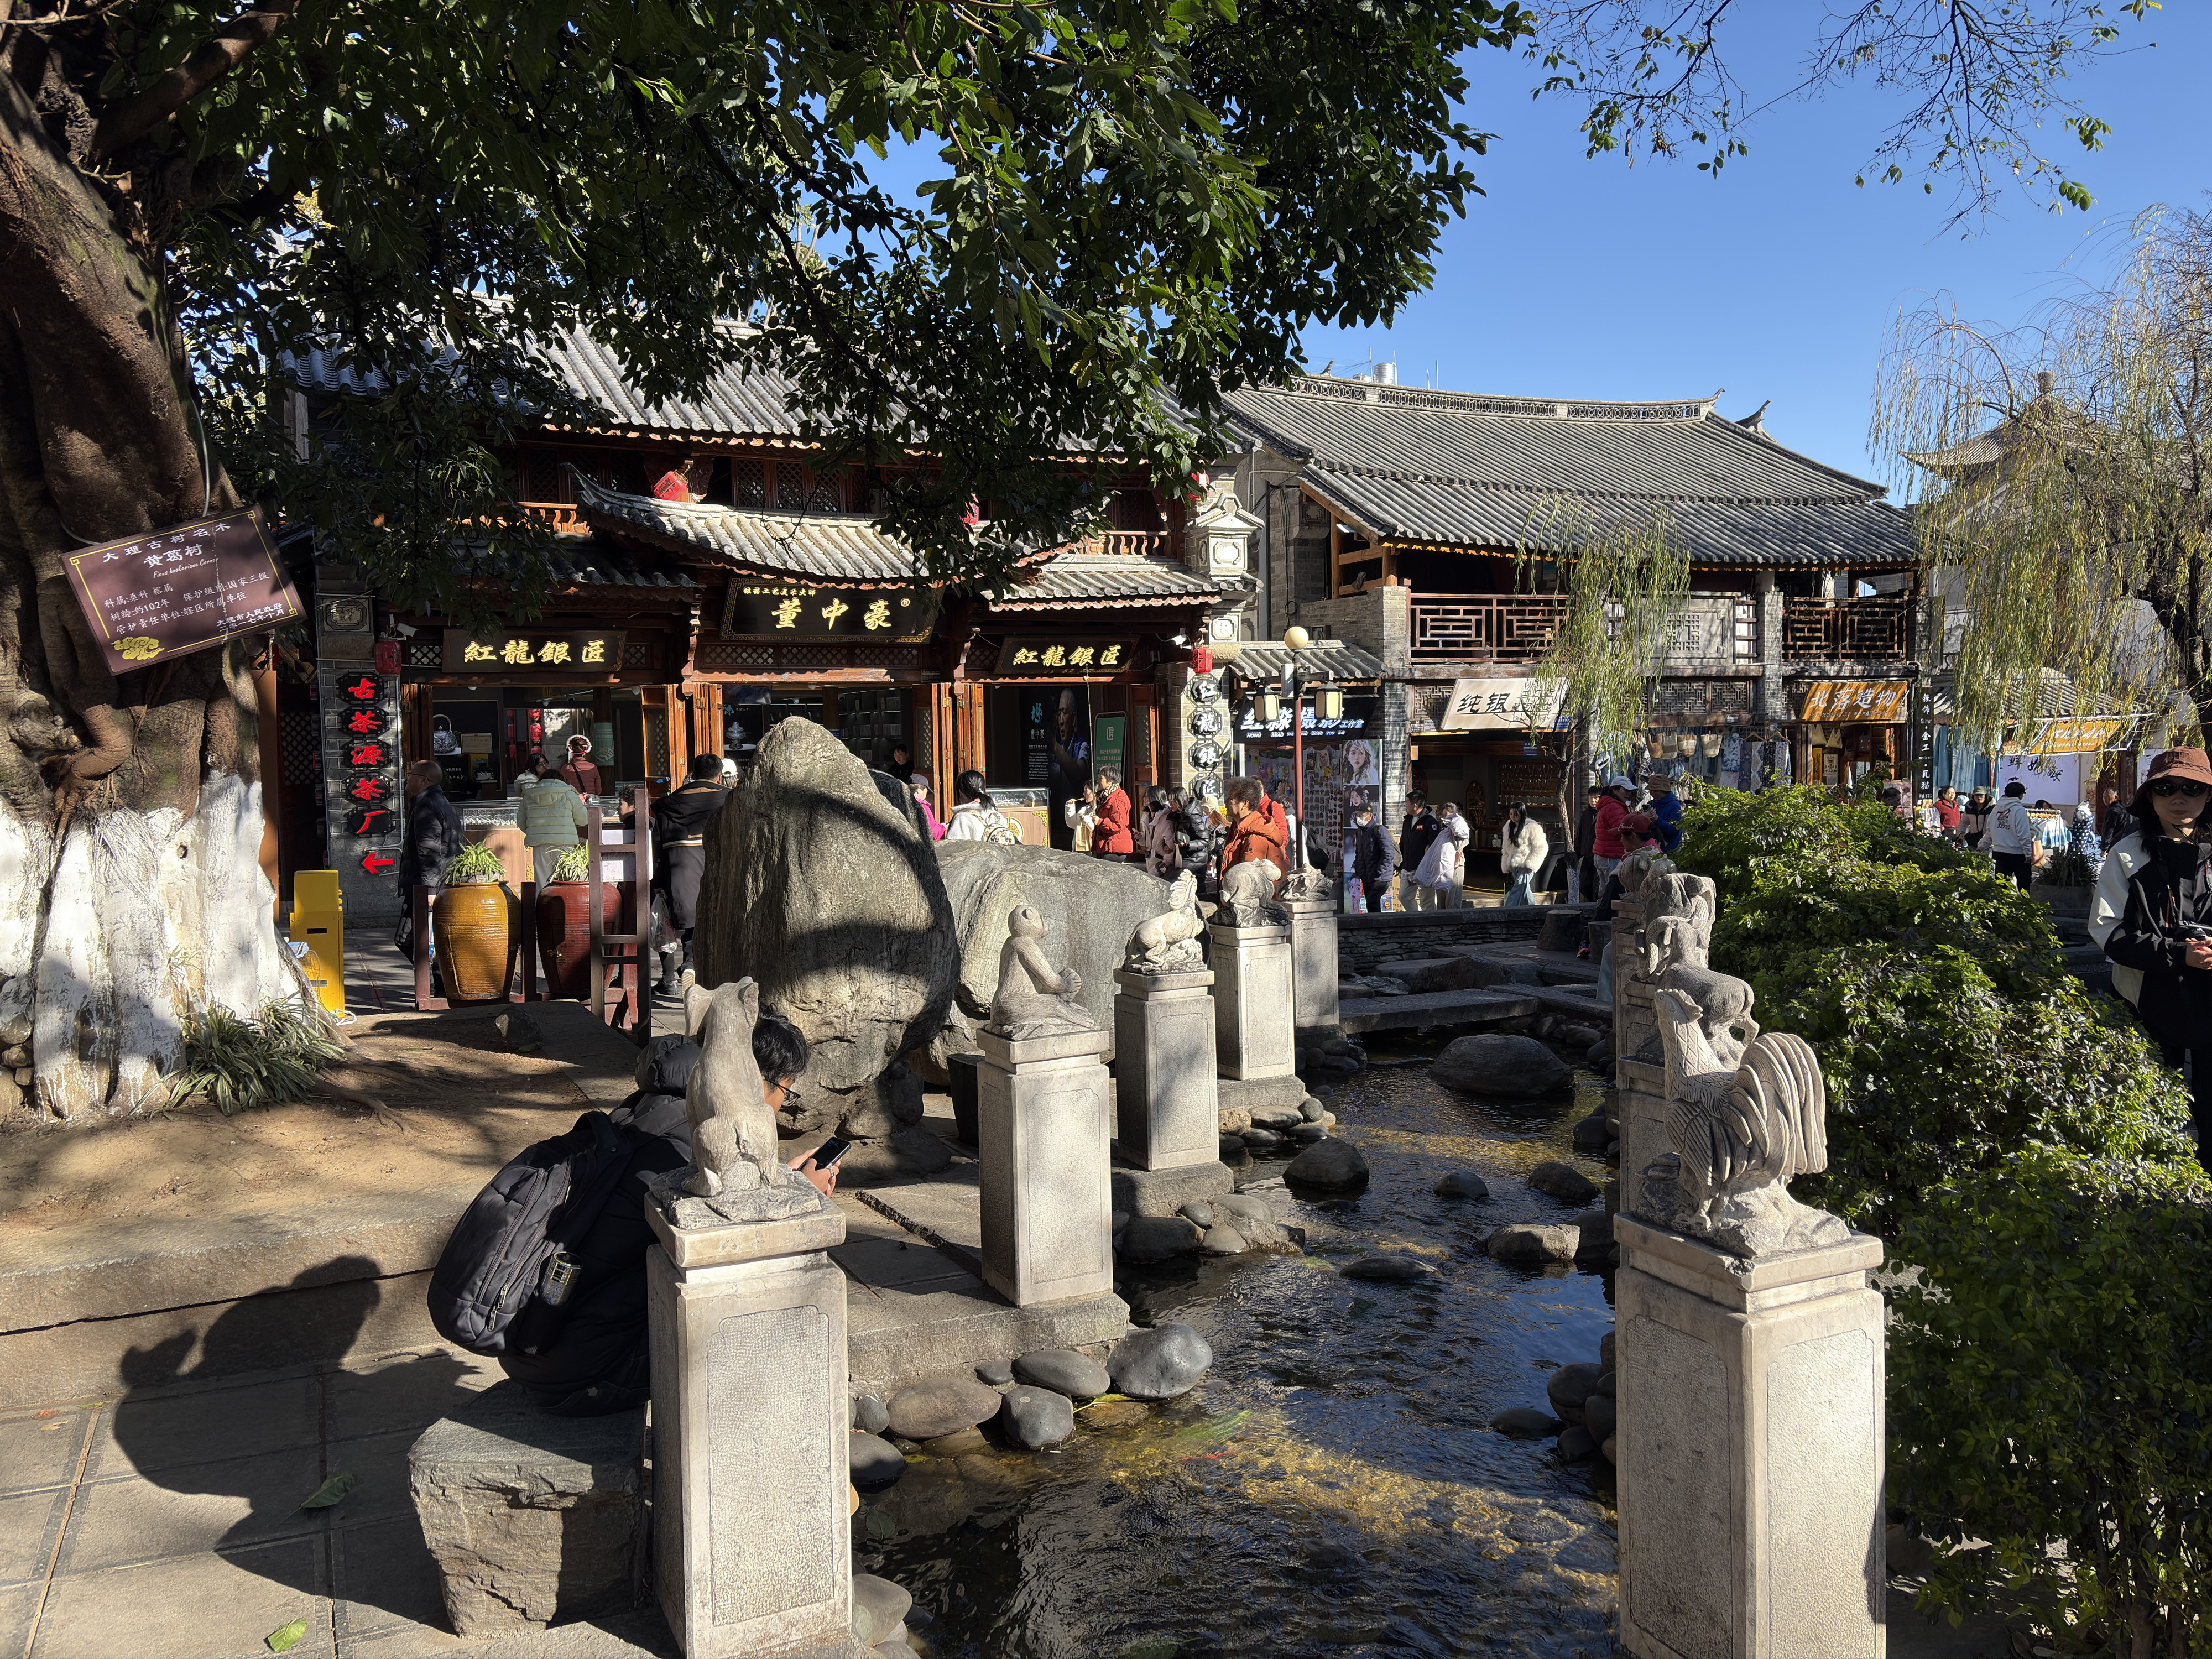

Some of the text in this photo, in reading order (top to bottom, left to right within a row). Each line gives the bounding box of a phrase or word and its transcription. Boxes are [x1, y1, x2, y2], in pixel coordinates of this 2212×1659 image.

[103, 523, 231, 562] 大理古树名木
[143, 544, 202, 568] 黄葛树
[153, 570, 168, 578] Ficus
[110, 572, 270, 621] 树龄:约102年 保护级别:国家三级
[153, 583, 173, 596] 榕属
[742, 587, 817, 597] 银器工艺美术大师
[116, 592, 248, 635] 管护责任单位:辖区所属单位
[216, 603, 283, 627] 大理市人民政府
[219, 609, 285, 632] 二零一七年十月
[771, 597, 892, 630] 董中豪
[464, 639, 605, 665] 紅龍銀匠
[1013, 644, 1121, 667] 紅龍銀匠
[1456, 692, 1511, 714] 纯银
[1810, 688, 1897, 710] 北落造物
[1922, 731, 1931, 752] 金工
[348, 678, 386, 834] 古茶源茶厂
